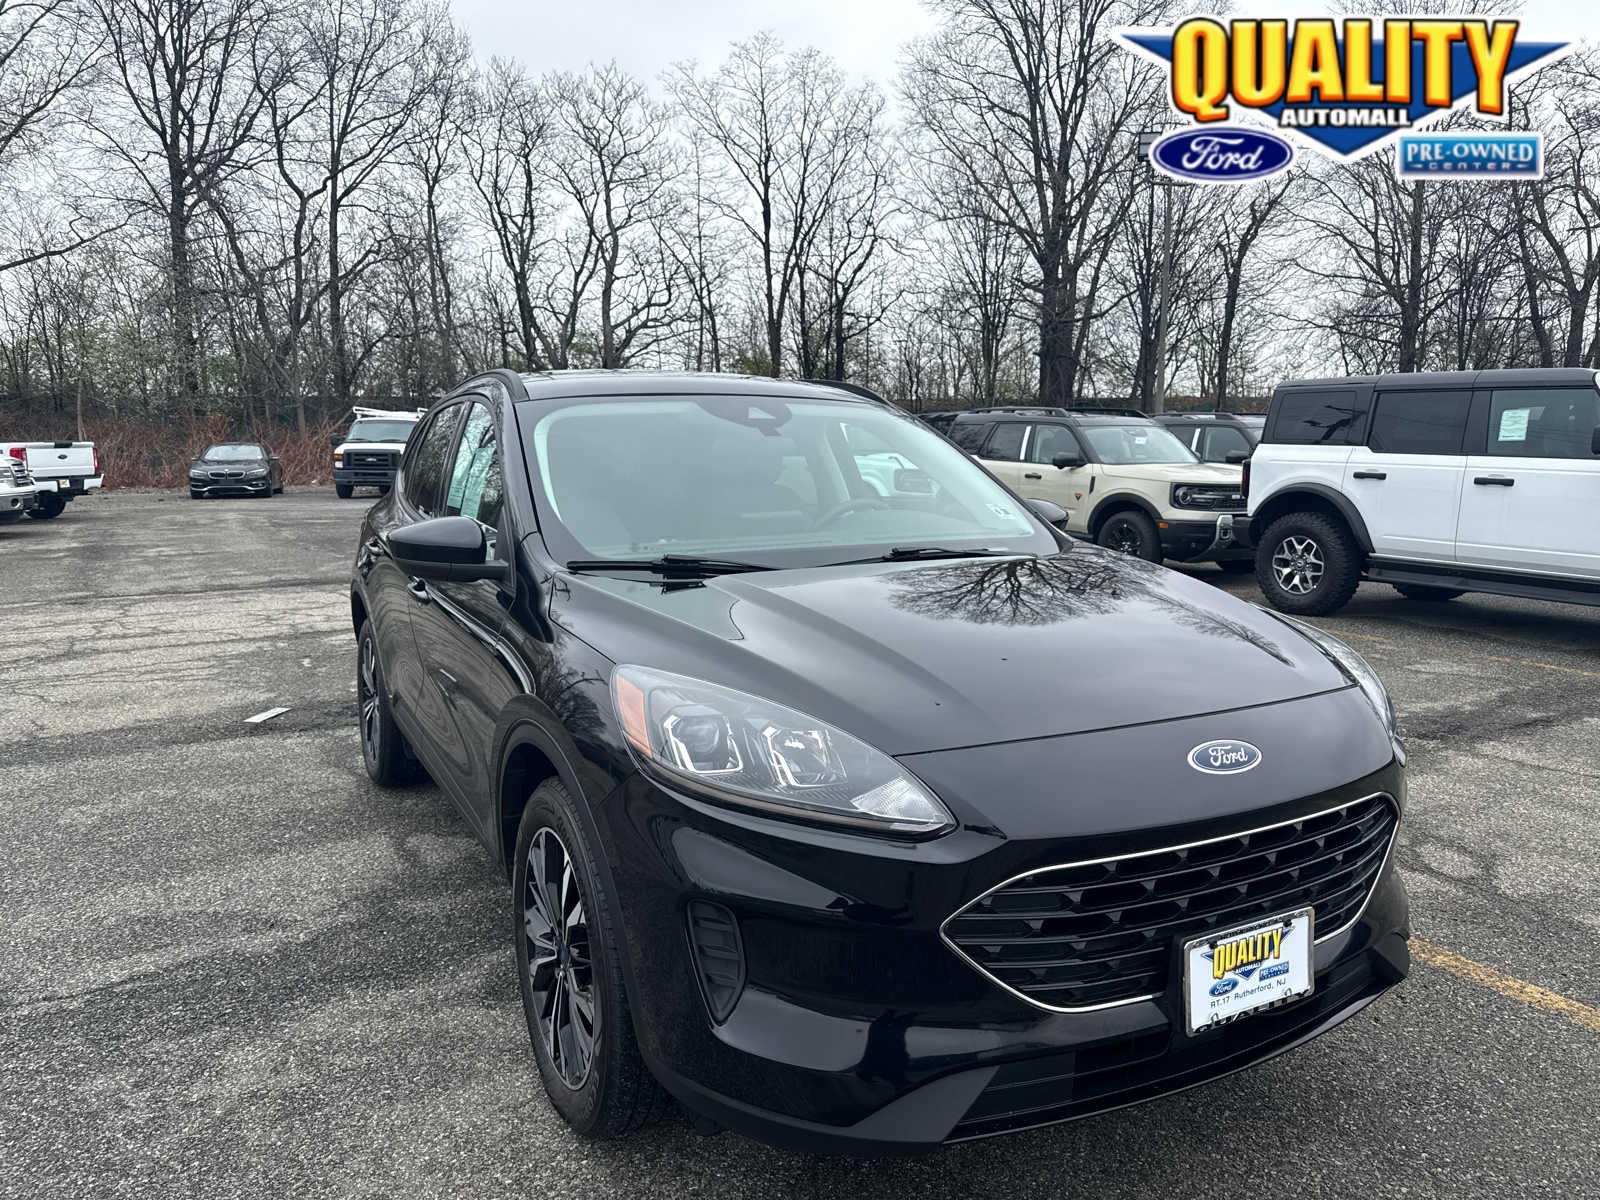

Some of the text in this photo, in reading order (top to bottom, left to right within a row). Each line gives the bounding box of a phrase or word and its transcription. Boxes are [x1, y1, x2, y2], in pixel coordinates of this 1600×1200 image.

[1208, 745, 1248, 767] Ford
[1212, 928, 1283, 979] QUALITY
[1235, 961, 1261, 974] AUTOMALL
[1210, 978, 1286, 1008] RT.17 Rutherford, NJ
[1214, 980, 1233, 995] Ford
